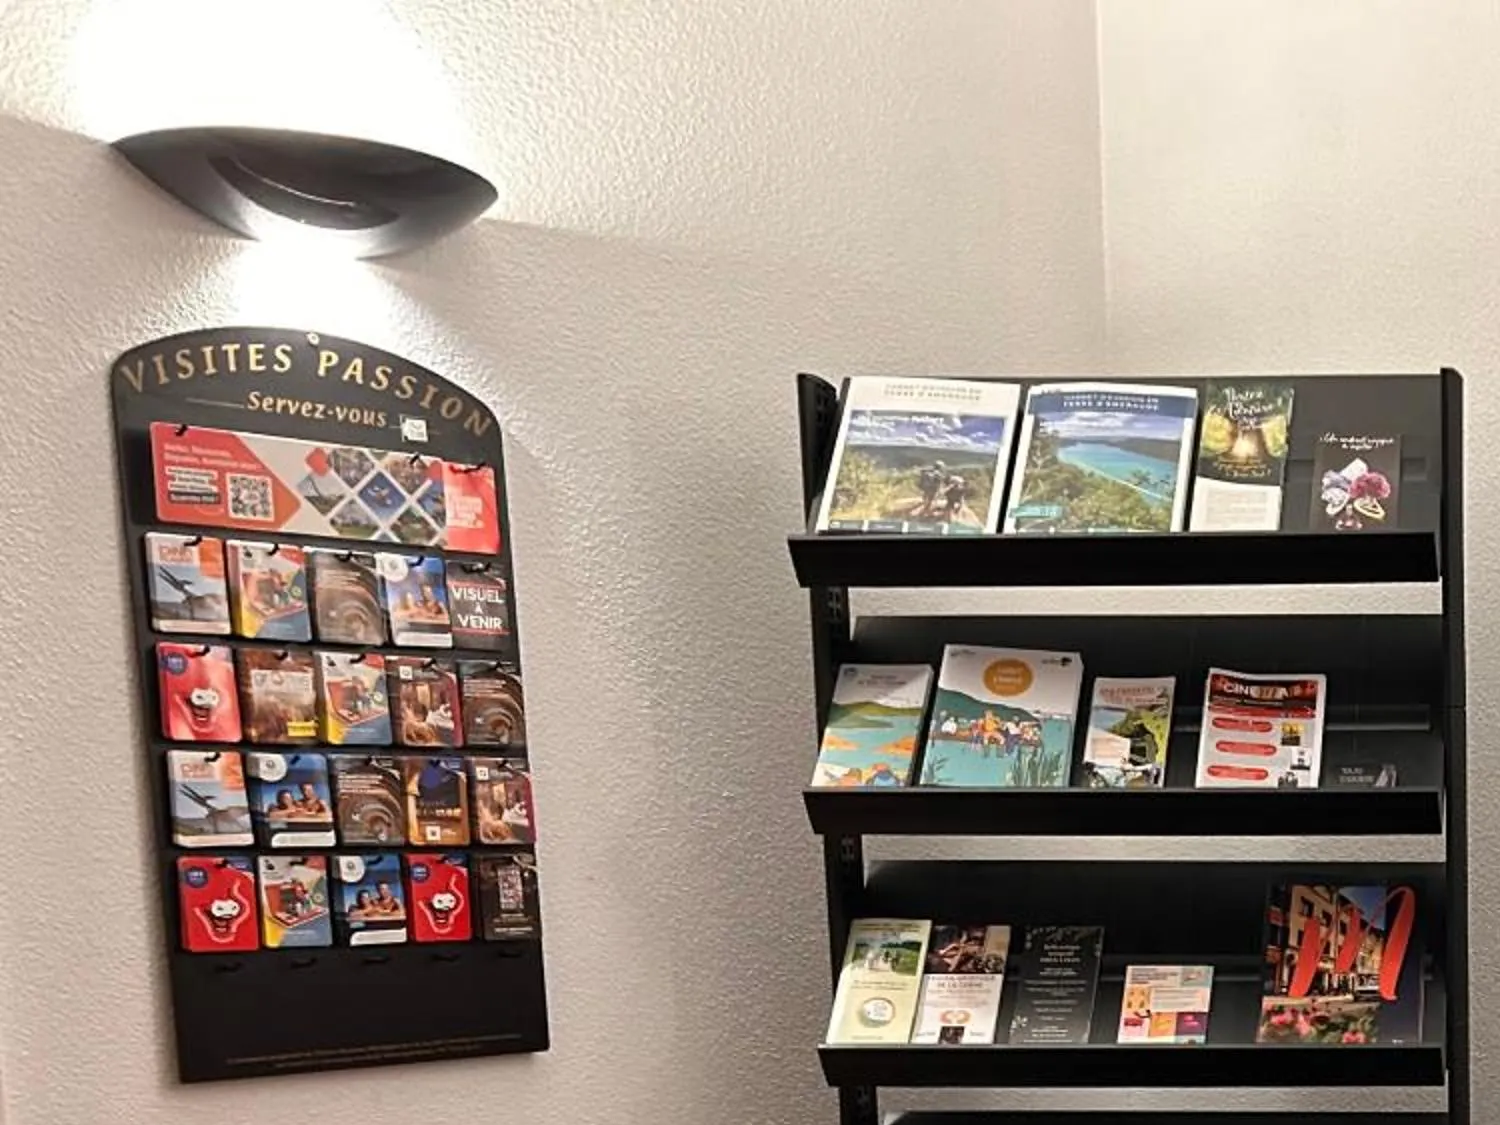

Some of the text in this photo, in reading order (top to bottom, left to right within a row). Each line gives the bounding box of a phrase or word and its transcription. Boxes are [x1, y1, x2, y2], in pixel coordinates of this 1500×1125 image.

[121, 343, 492, 436] VISITES PASSION
[247, 391, 388, 429] Servez-vous
[451, 585, 505, 604] VISUEL
[457, 613, 504, 630] VENIR
